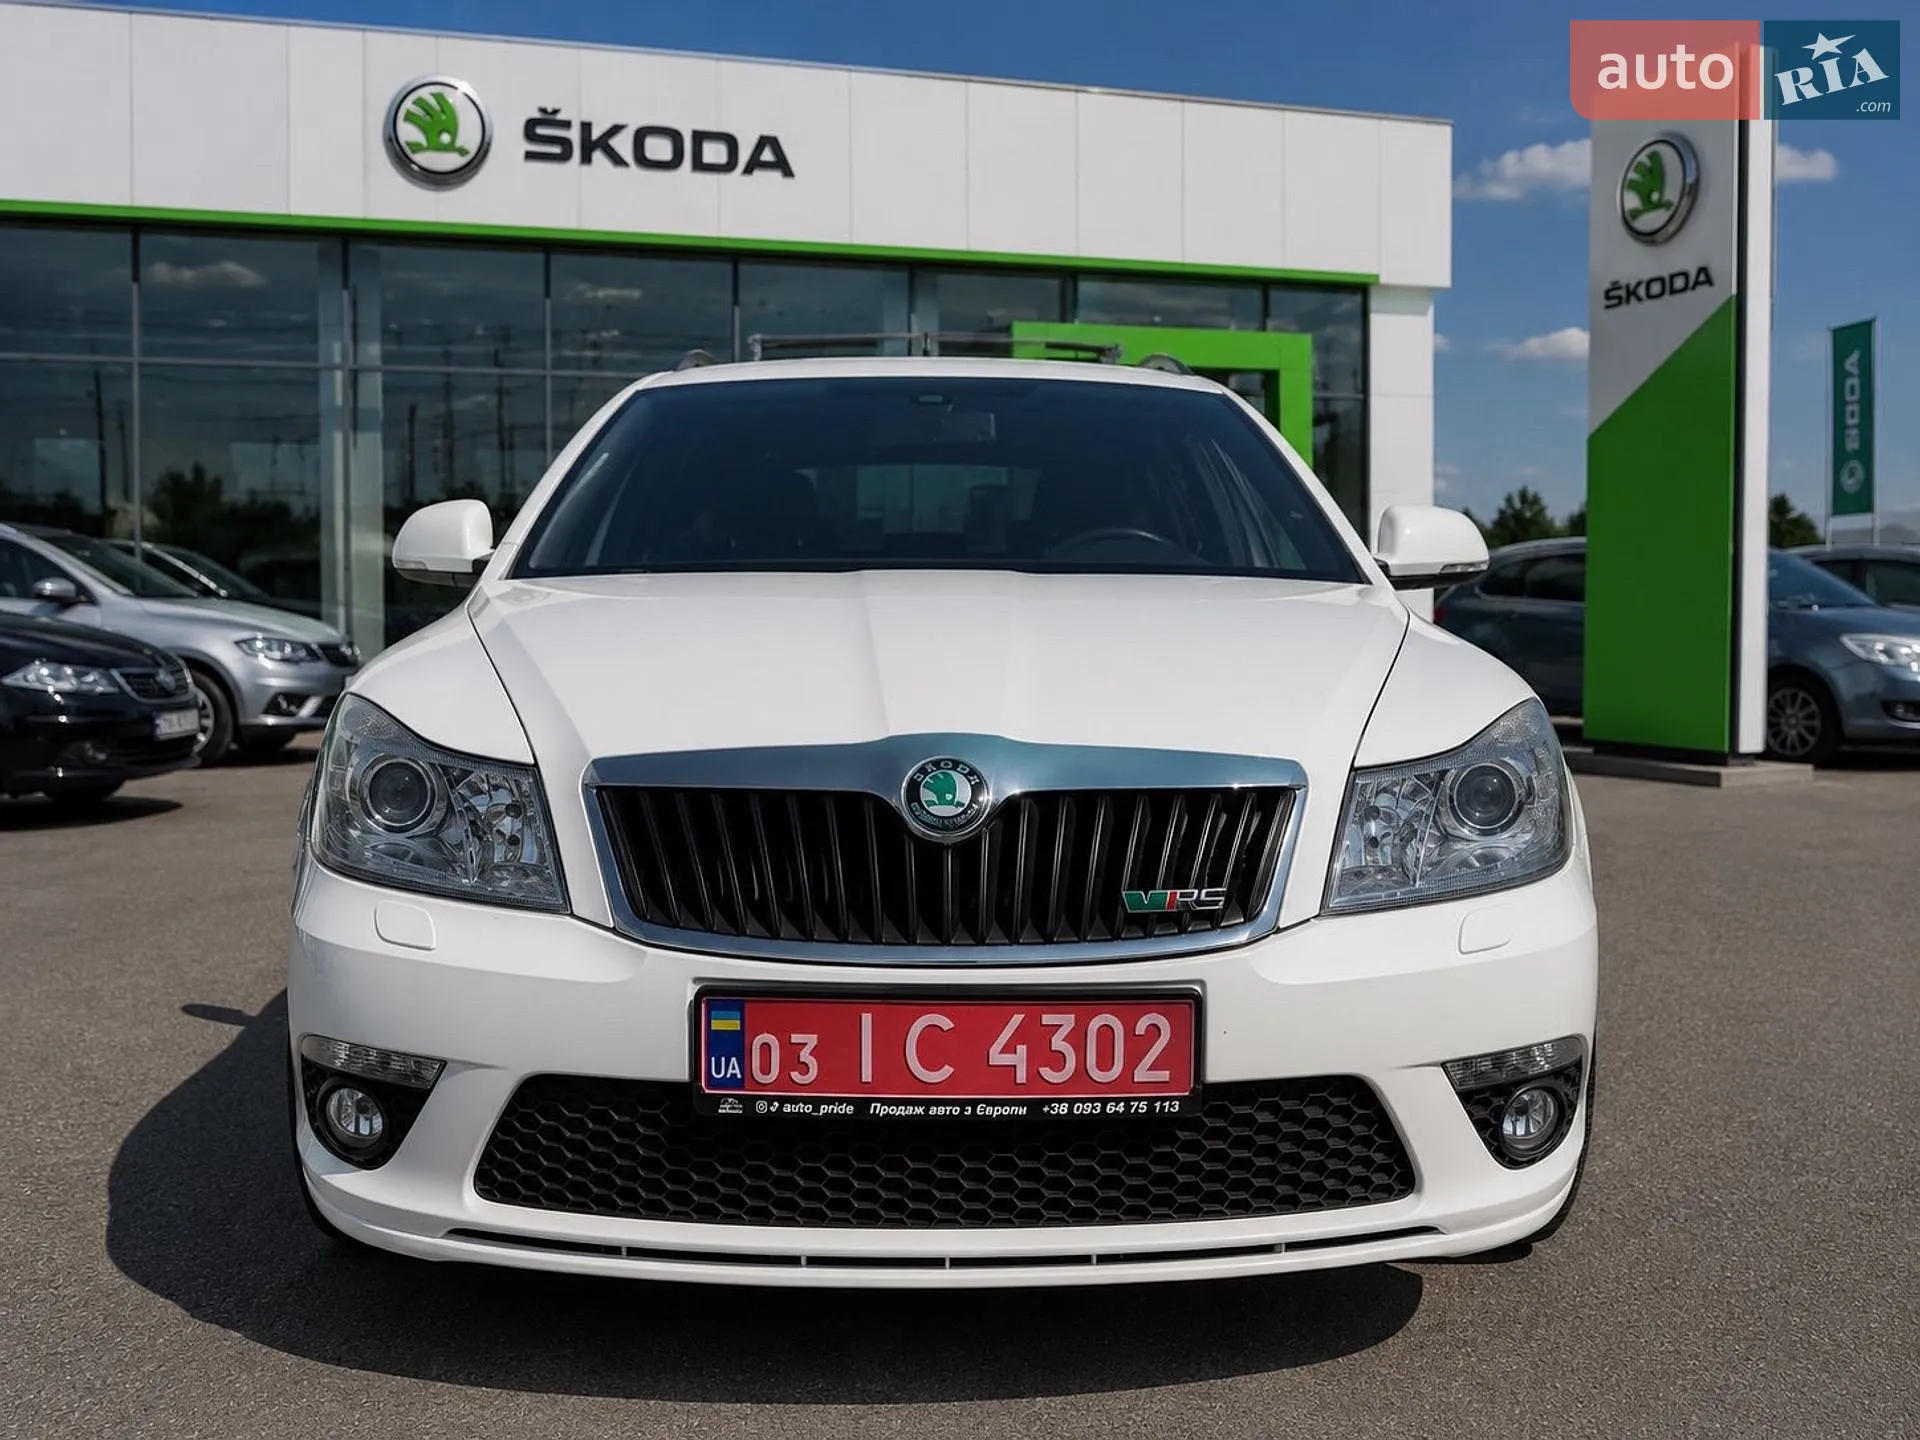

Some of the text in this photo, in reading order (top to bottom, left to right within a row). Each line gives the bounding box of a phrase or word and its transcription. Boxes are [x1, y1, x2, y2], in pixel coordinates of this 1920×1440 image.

[523, 106, 796, 179] ŠKODA
[1603, 264, 1716, 310] ŠKODA
[751, 1032, 819, 1085] 03
[987, 1013, 1173, 1085] 4302
[711, 1056, 742, 1079] UA
[782, 1101, 855, 1116] auto_pride
[869, 1102, 925, 1117] Продаж
[928, 1105, 960, 1116] авто
[963, 1105, 972, 1116] з
[1042, 1100, 1180, 1115] +38 093 64 75 113
